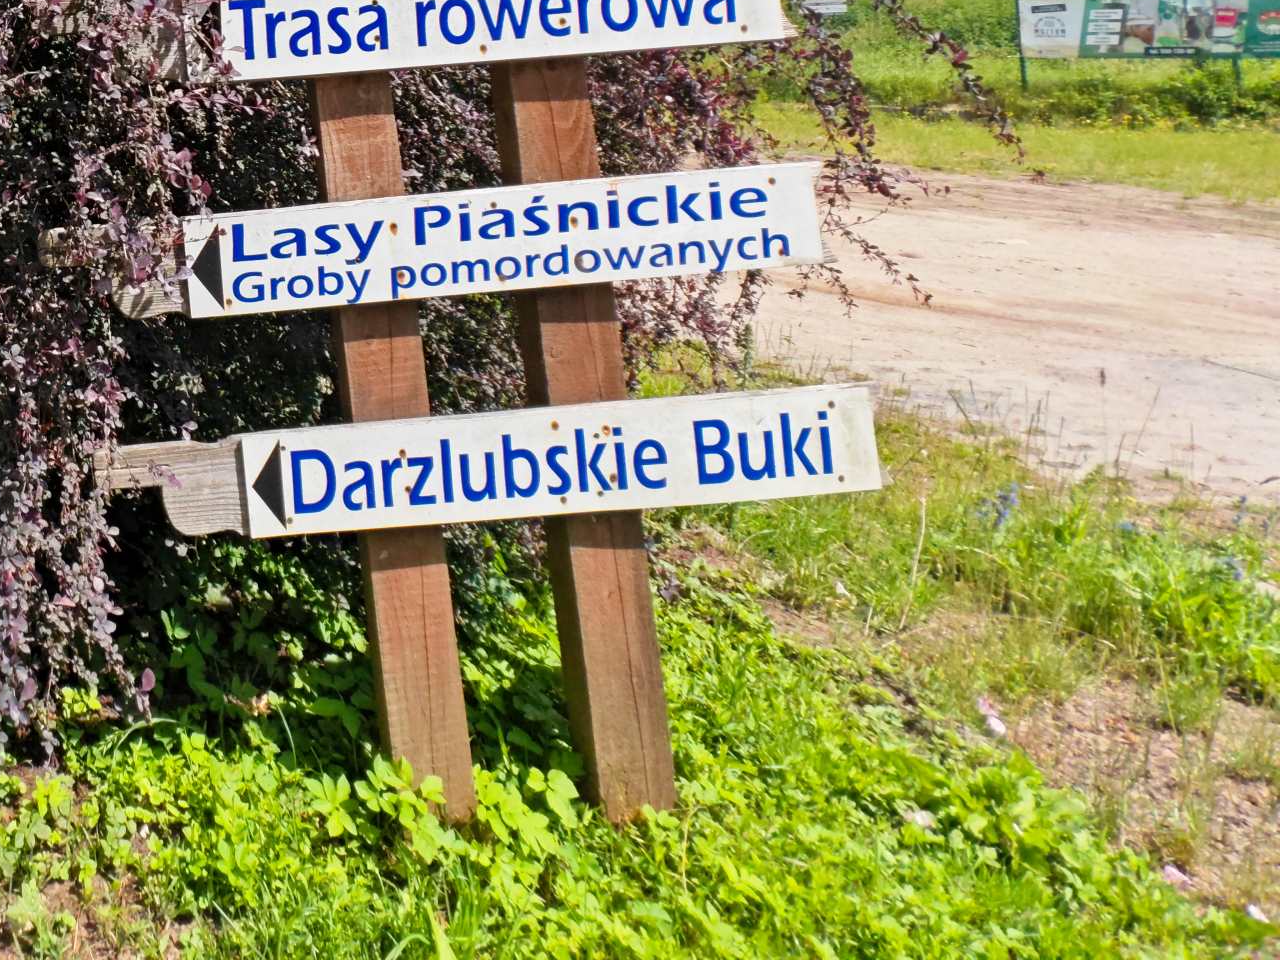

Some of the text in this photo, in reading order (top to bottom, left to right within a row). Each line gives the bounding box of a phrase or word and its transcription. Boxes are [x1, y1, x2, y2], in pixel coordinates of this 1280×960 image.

[231, 181, 768, 264] Lasy Piaśnickie
[231, 228, 791, 305] Groby pomordowanych
[692, 410, 834, 485] Buki
